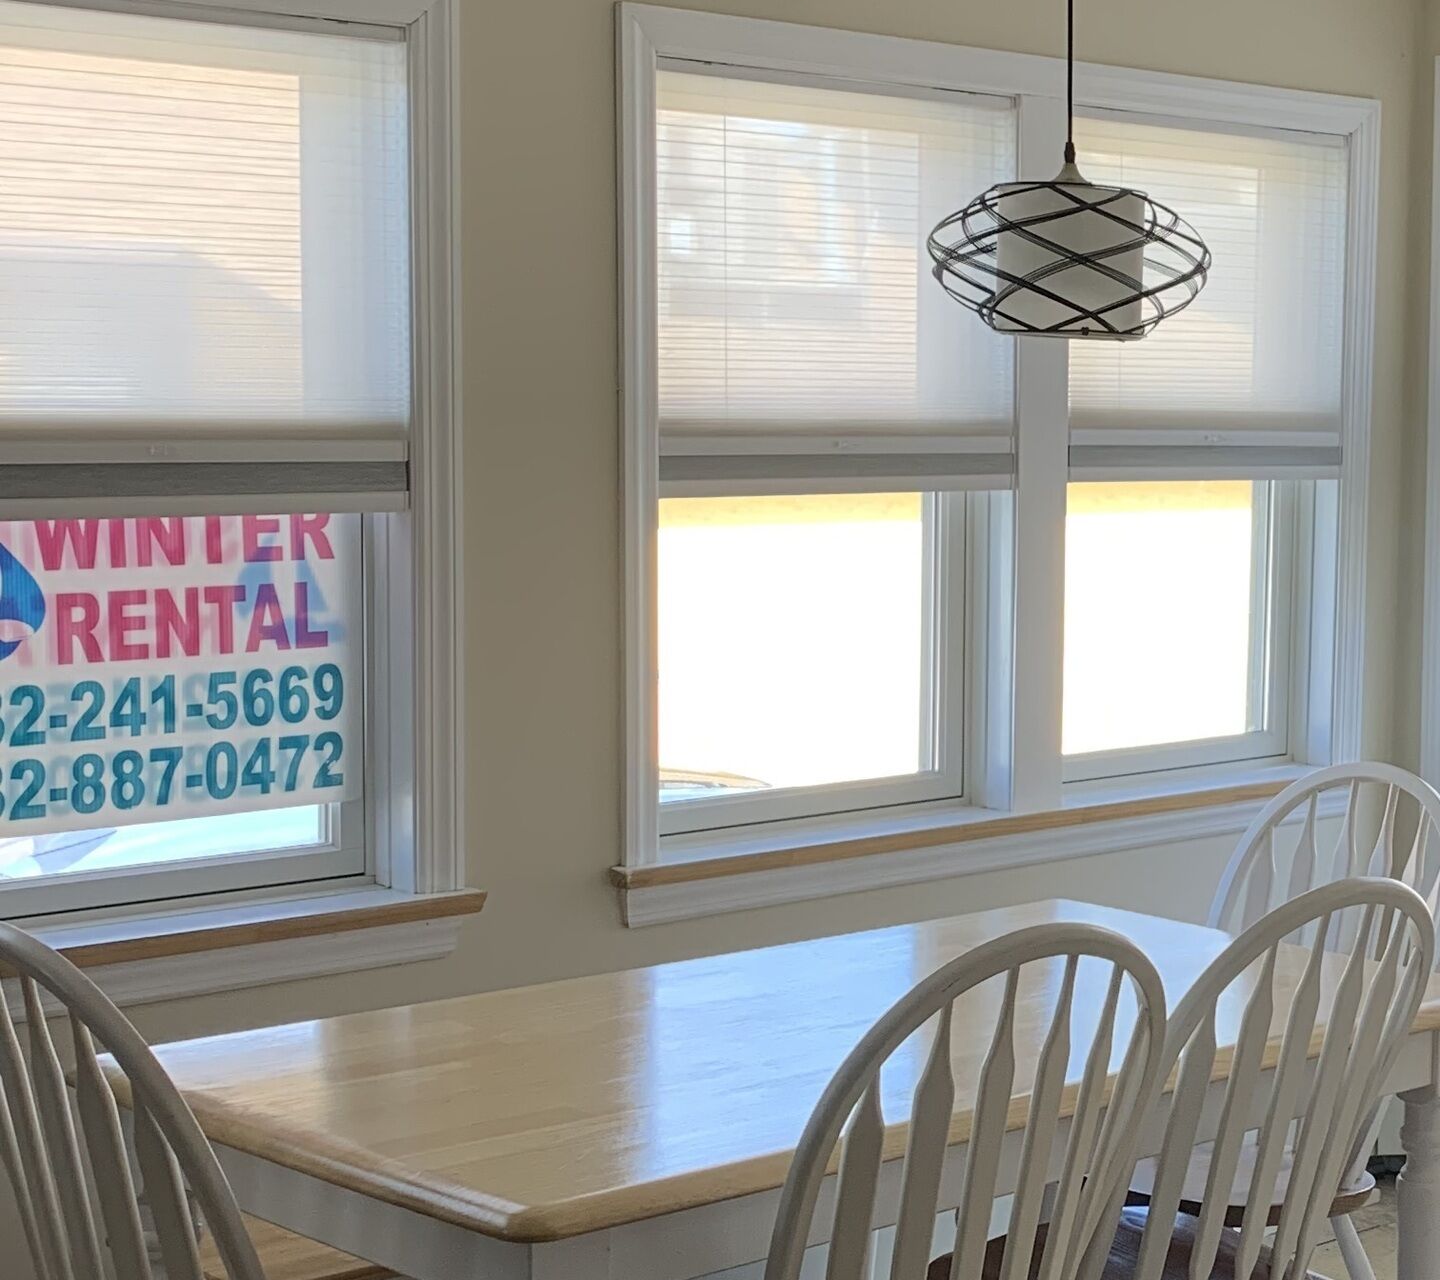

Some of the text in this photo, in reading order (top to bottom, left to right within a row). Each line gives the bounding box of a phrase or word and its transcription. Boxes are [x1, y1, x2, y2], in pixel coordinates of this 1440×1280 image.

[33, 512, 336, 572] WINTER
[55, 581, 330, 666] RENTAL
[0, 662, 345, 748] 2-241-5669
[0, 730, 345, 821] 2-887-0472
